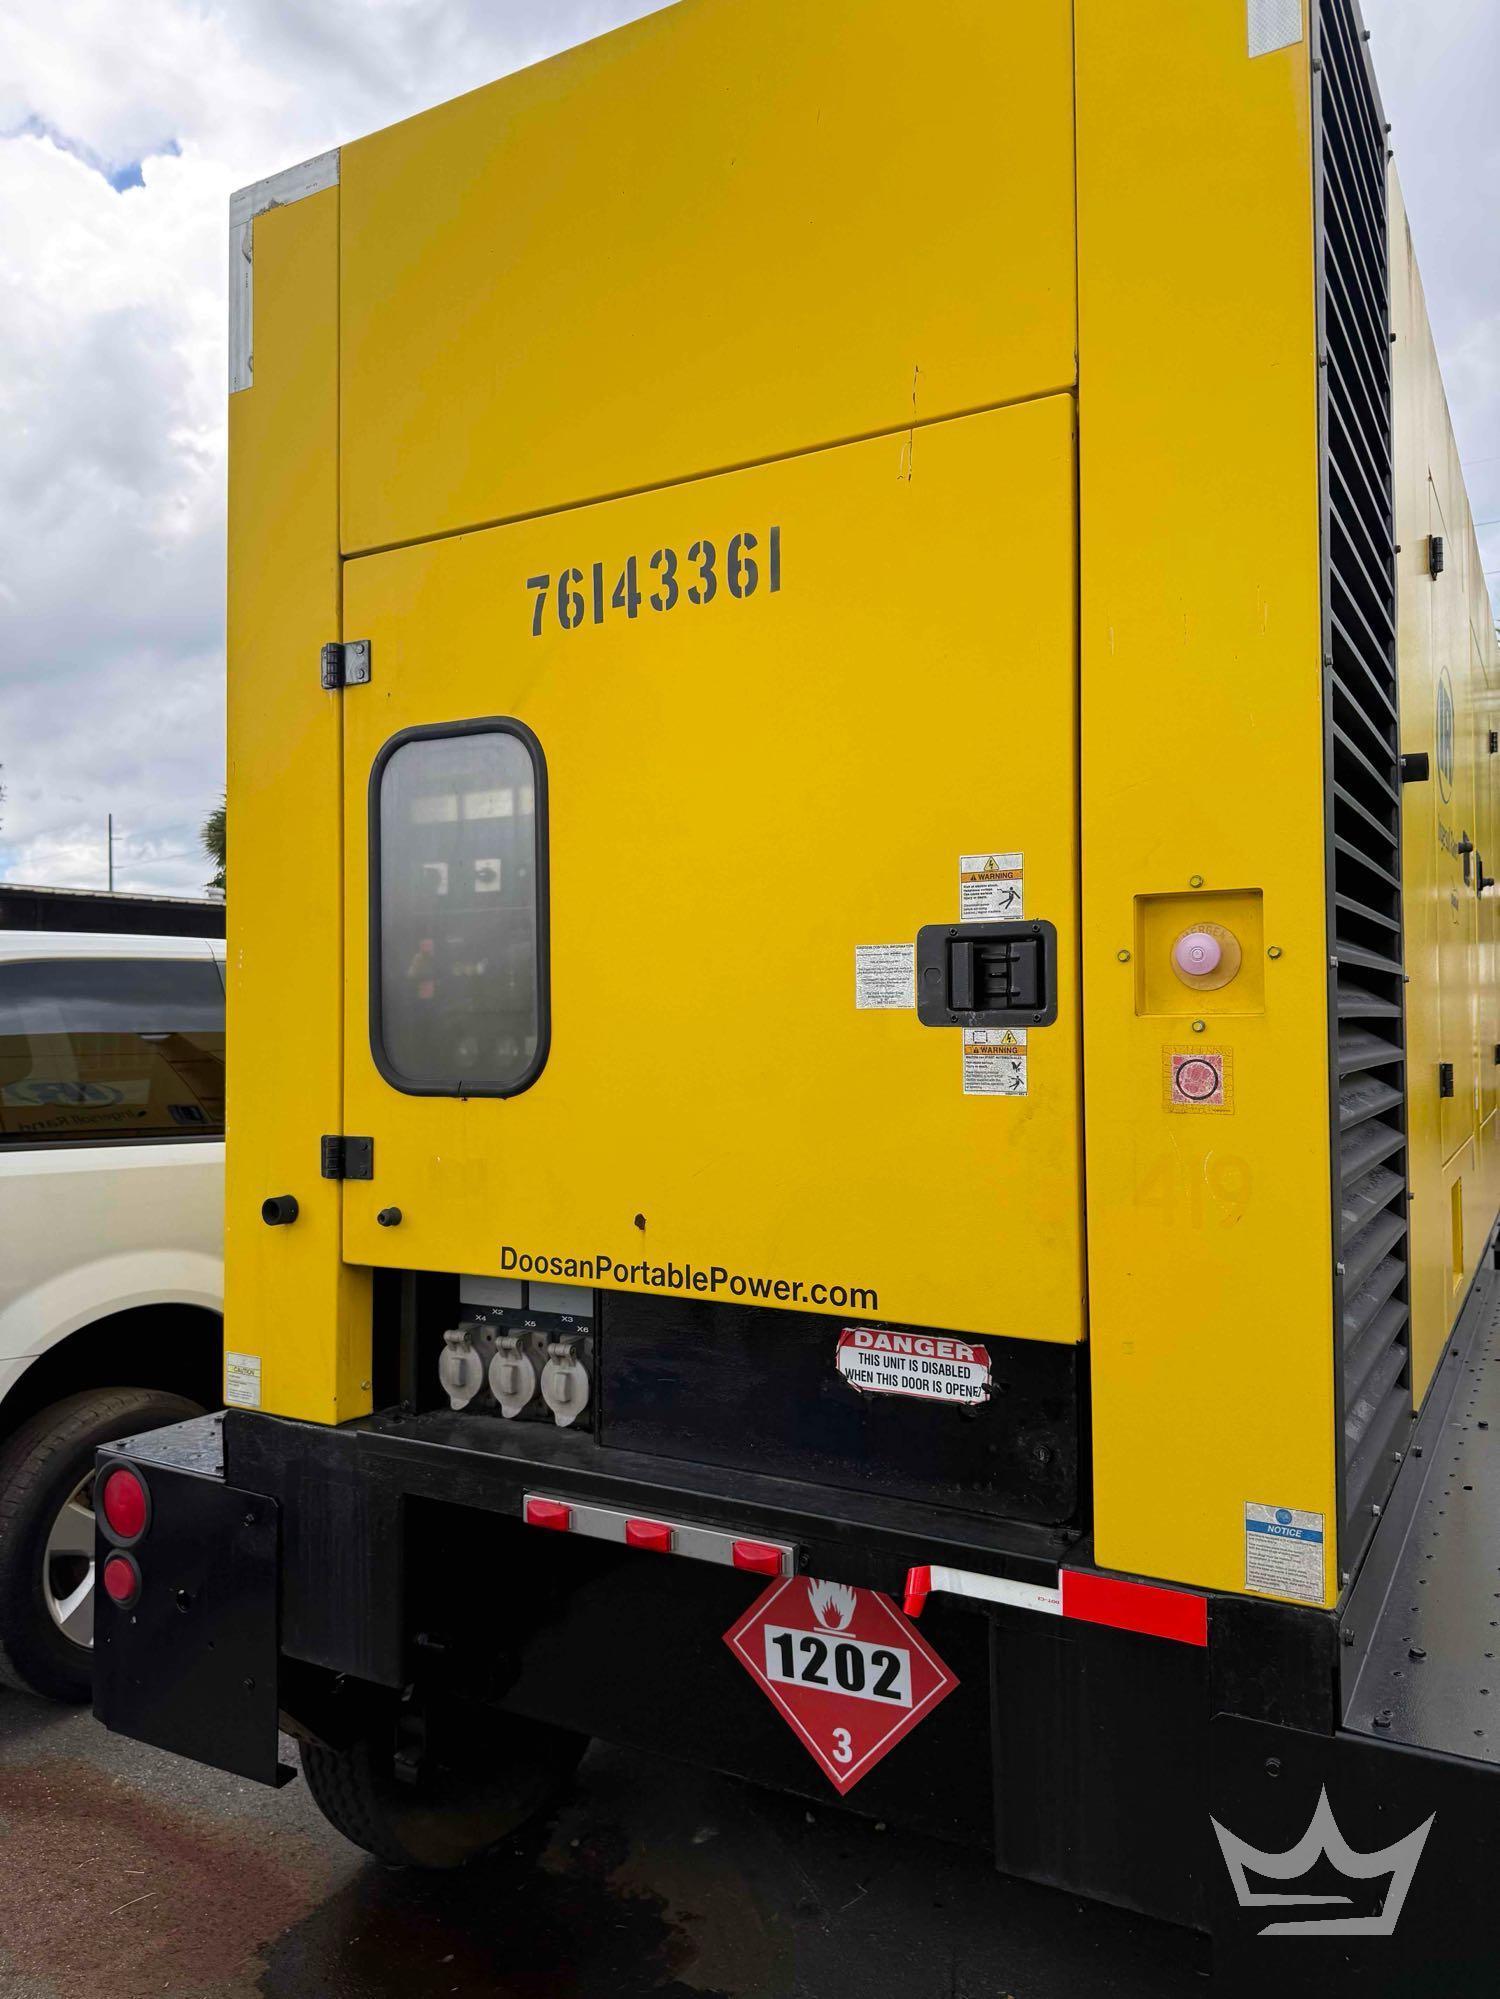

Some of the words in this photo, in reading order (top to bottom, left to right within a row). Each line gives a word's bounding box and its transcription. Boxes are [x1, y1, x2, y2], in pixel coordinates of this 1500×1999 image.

[526, 526, 781, 637] 76143361
[978, 872, 1014, 880] WARNING
[500, 1246, 878, 1311] DoosanPortablePower.com
[492, 1308, 504, 1316] X2
[561, 1315, 574, 1323] X3
[854, 1331, 975, 1362] DANGER
[858, 1352, 880, 1366] THIS
[883, 1355, 907, 1371] UNIT
[909, 1359, 919, 1373] IS
[921, 1361, 971, 1379] DISABLED
[845, 1367, 874, 1383] WHEN
[876, 1372, 898, 1387] THIS
[901, 1376, 930, 1392] DOOR
[932, 1380, 942, 1393] IS
[1267, 1525, 1303, 1538] NOTICE
[772, 1632, 902, 1701] 1202
[832, 1727, 852, 1764] 3
